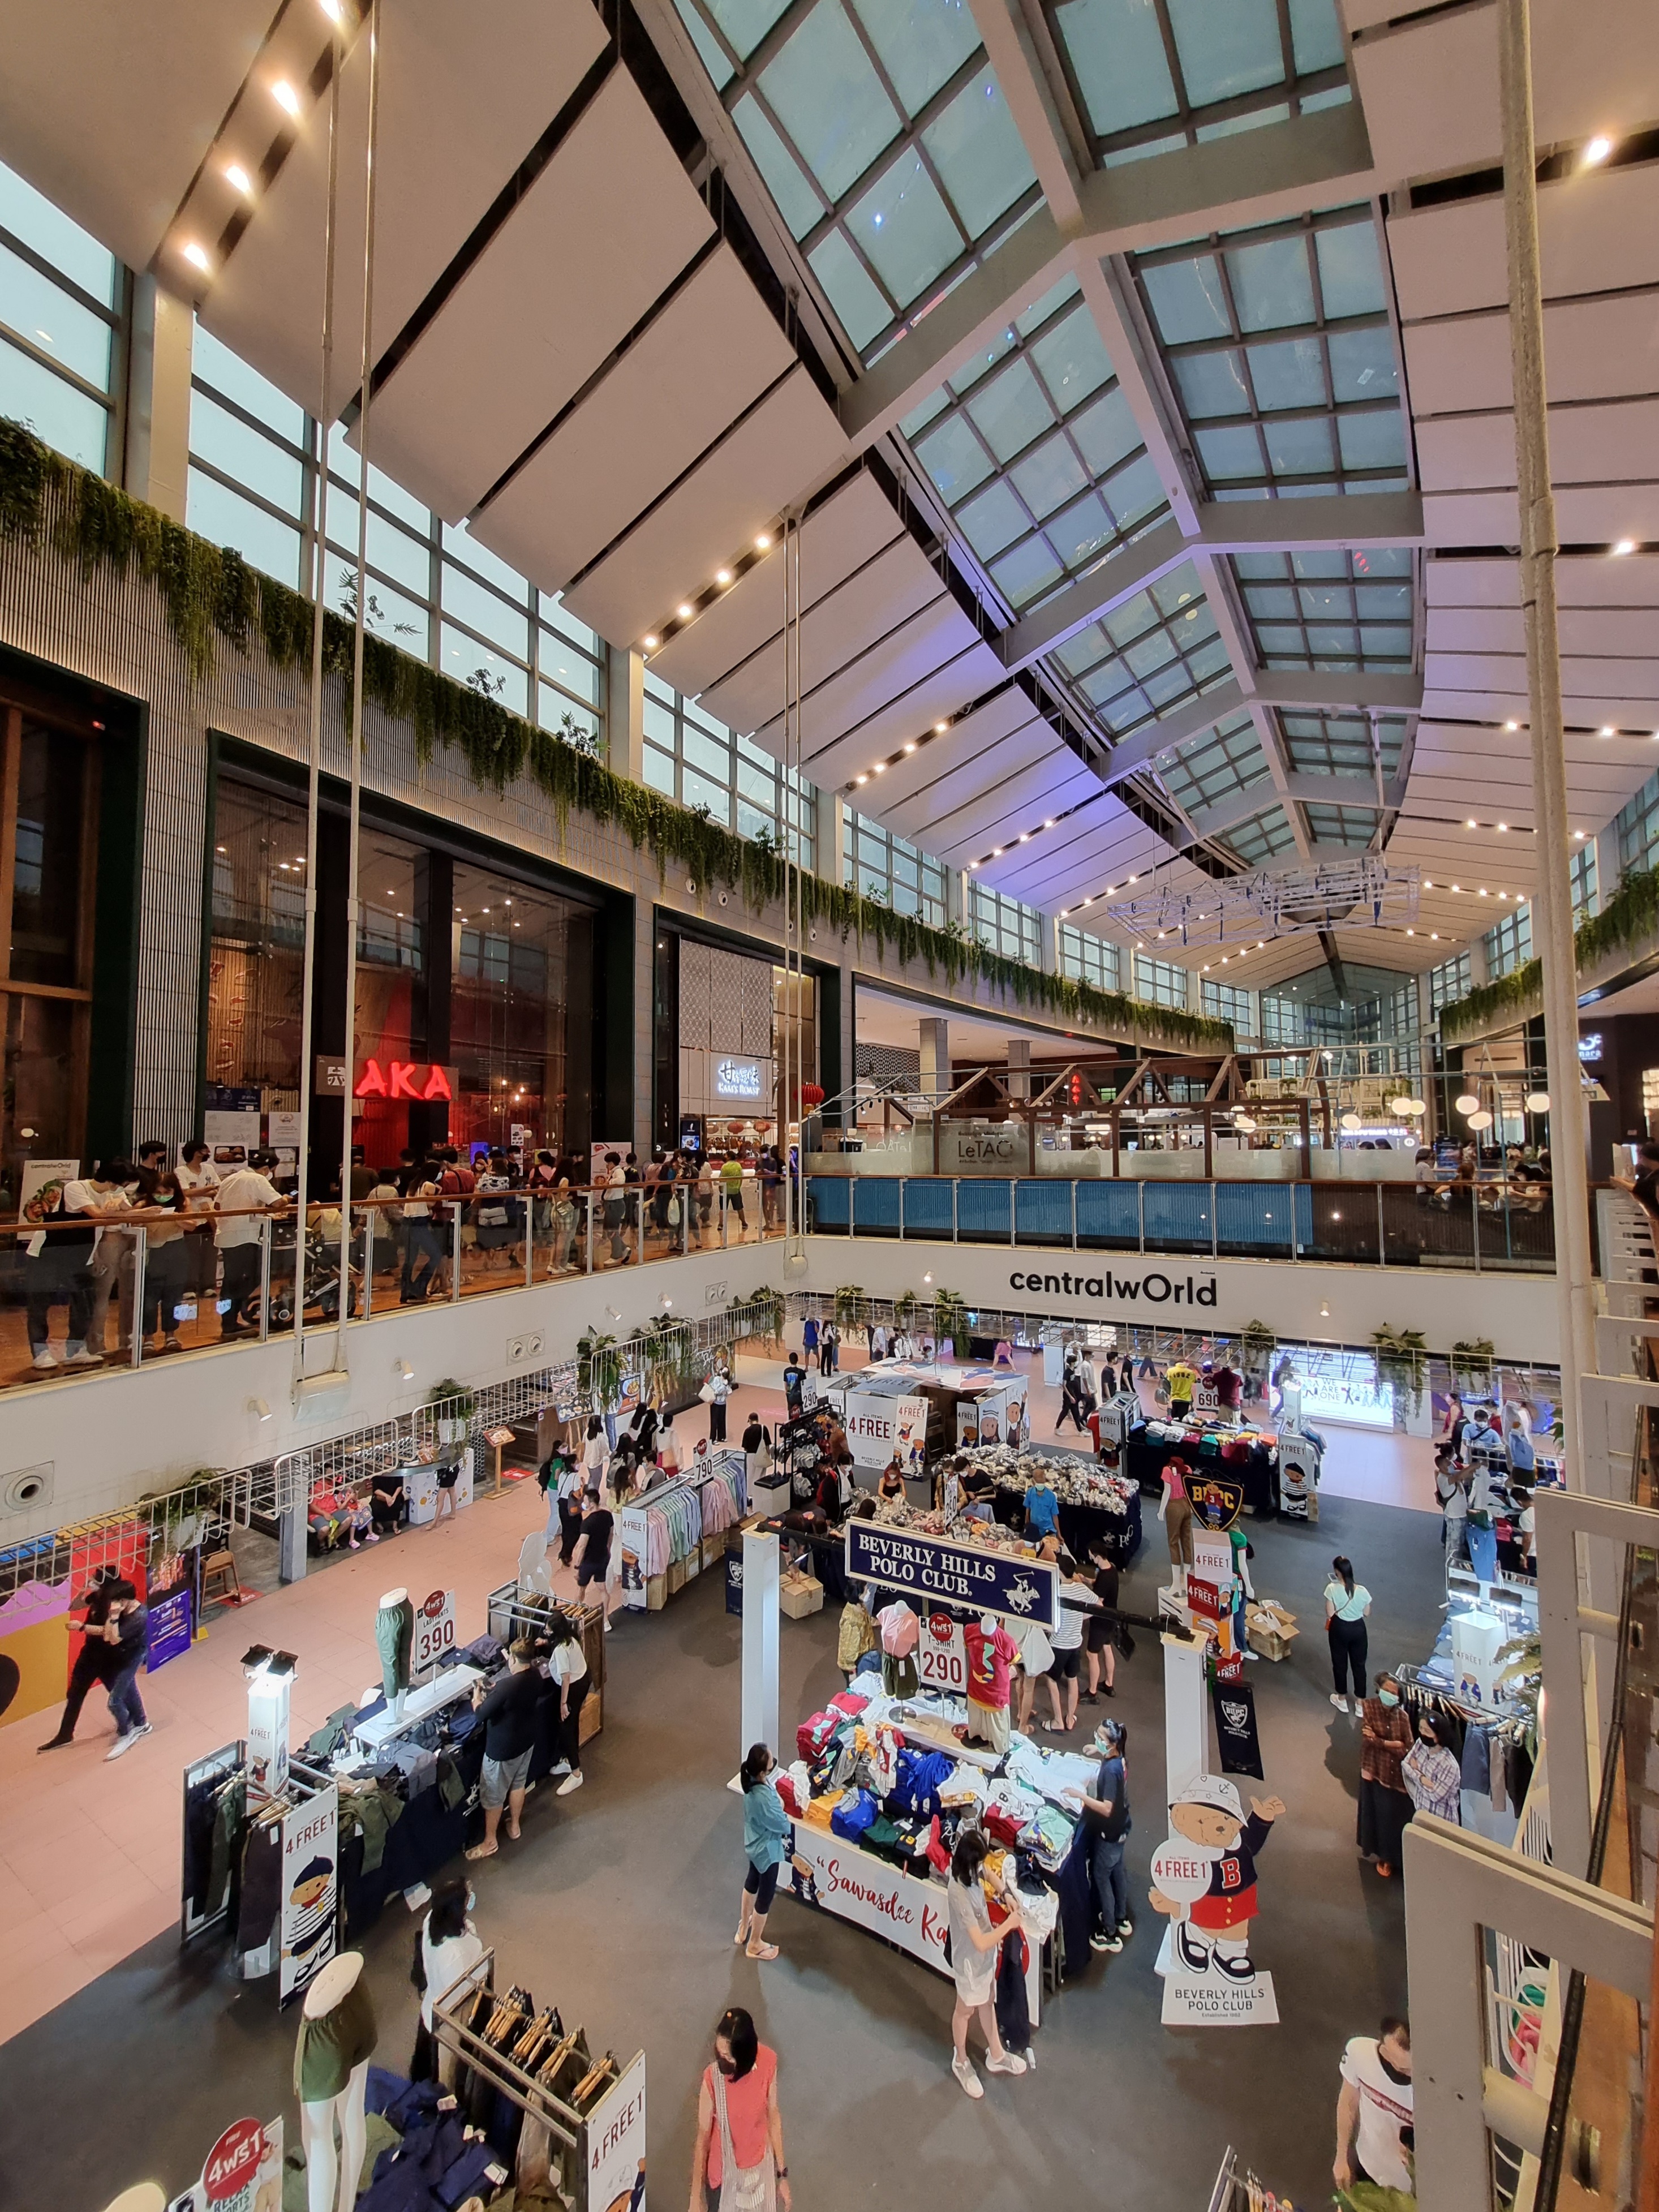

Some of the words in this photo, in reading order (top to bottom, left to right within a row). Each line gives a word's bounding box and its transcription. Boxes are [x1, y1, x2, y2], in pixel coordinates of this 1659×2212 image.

[355, 1059, 452, 1099] AKA
[958, 1140, 1013, 1158] LeTAO
[1009, 1271, 1218, 1306] centralwOrld
[1320, 1392, 1340, 1401] ONE
[1321, 1385, 1339, 1394] ARE
[803, 1392, 816, 1408] 290
[1198, 1393, 1220, 1407] 690
[899, 1406, 903, 1415] 4
[904, 1407, 921, 1418] FREE
[962, 1412, 973, 1420] FREE
[849, 1416, 856, 1433] 4
[859, 1417, 890, 1439] FREE
[1103, 1416, 1116, 1425] FREE
[1286, 1445, 1301, 1455] FREE
[695, 1459, 712, 1481] 790
[628, 1521, 642, 1531] FREE
[858, 1534, 935, 1566] BEVERLY
[940, 1553, 996, 1583] HILLS
[1196, 1554, 1201, 1565] 4
[1202, 1555, 1224, 1567] FREE
[870, 1555, 915, 1581] POLO
[1188, 1585, 1193, 1596] 4
[1194, 1586, 1213, 1604] FREE
[420, 1619, 454, 1660] 390
[1461, 1652, 1477, 1664] FREE
[923, 1651, 962, 1683] 290
[1221, 1664, 1236, 1678] FREE
[255, 1729, 267, 1739] FREE
[286, 1838, 294, 1854] 4
[296, 1814, 328, 1849] FREE
[1154, 1860, 1163, 1876] 4
[1165, 1861, 1198, 1878] FREE
[1220, 1857, 1241, 1889] B
[1175, 1989, 1227, 1999] BEVERLY
[1231, 1988, 1265, 1999] HILLS
[1188, 2001, 1219, 2011] POLO
[1222, 2000, 1253, 2011] CLUB
[592, 2146, 600, 2170] 4
[603, 2099, 634, 2160] FREE
